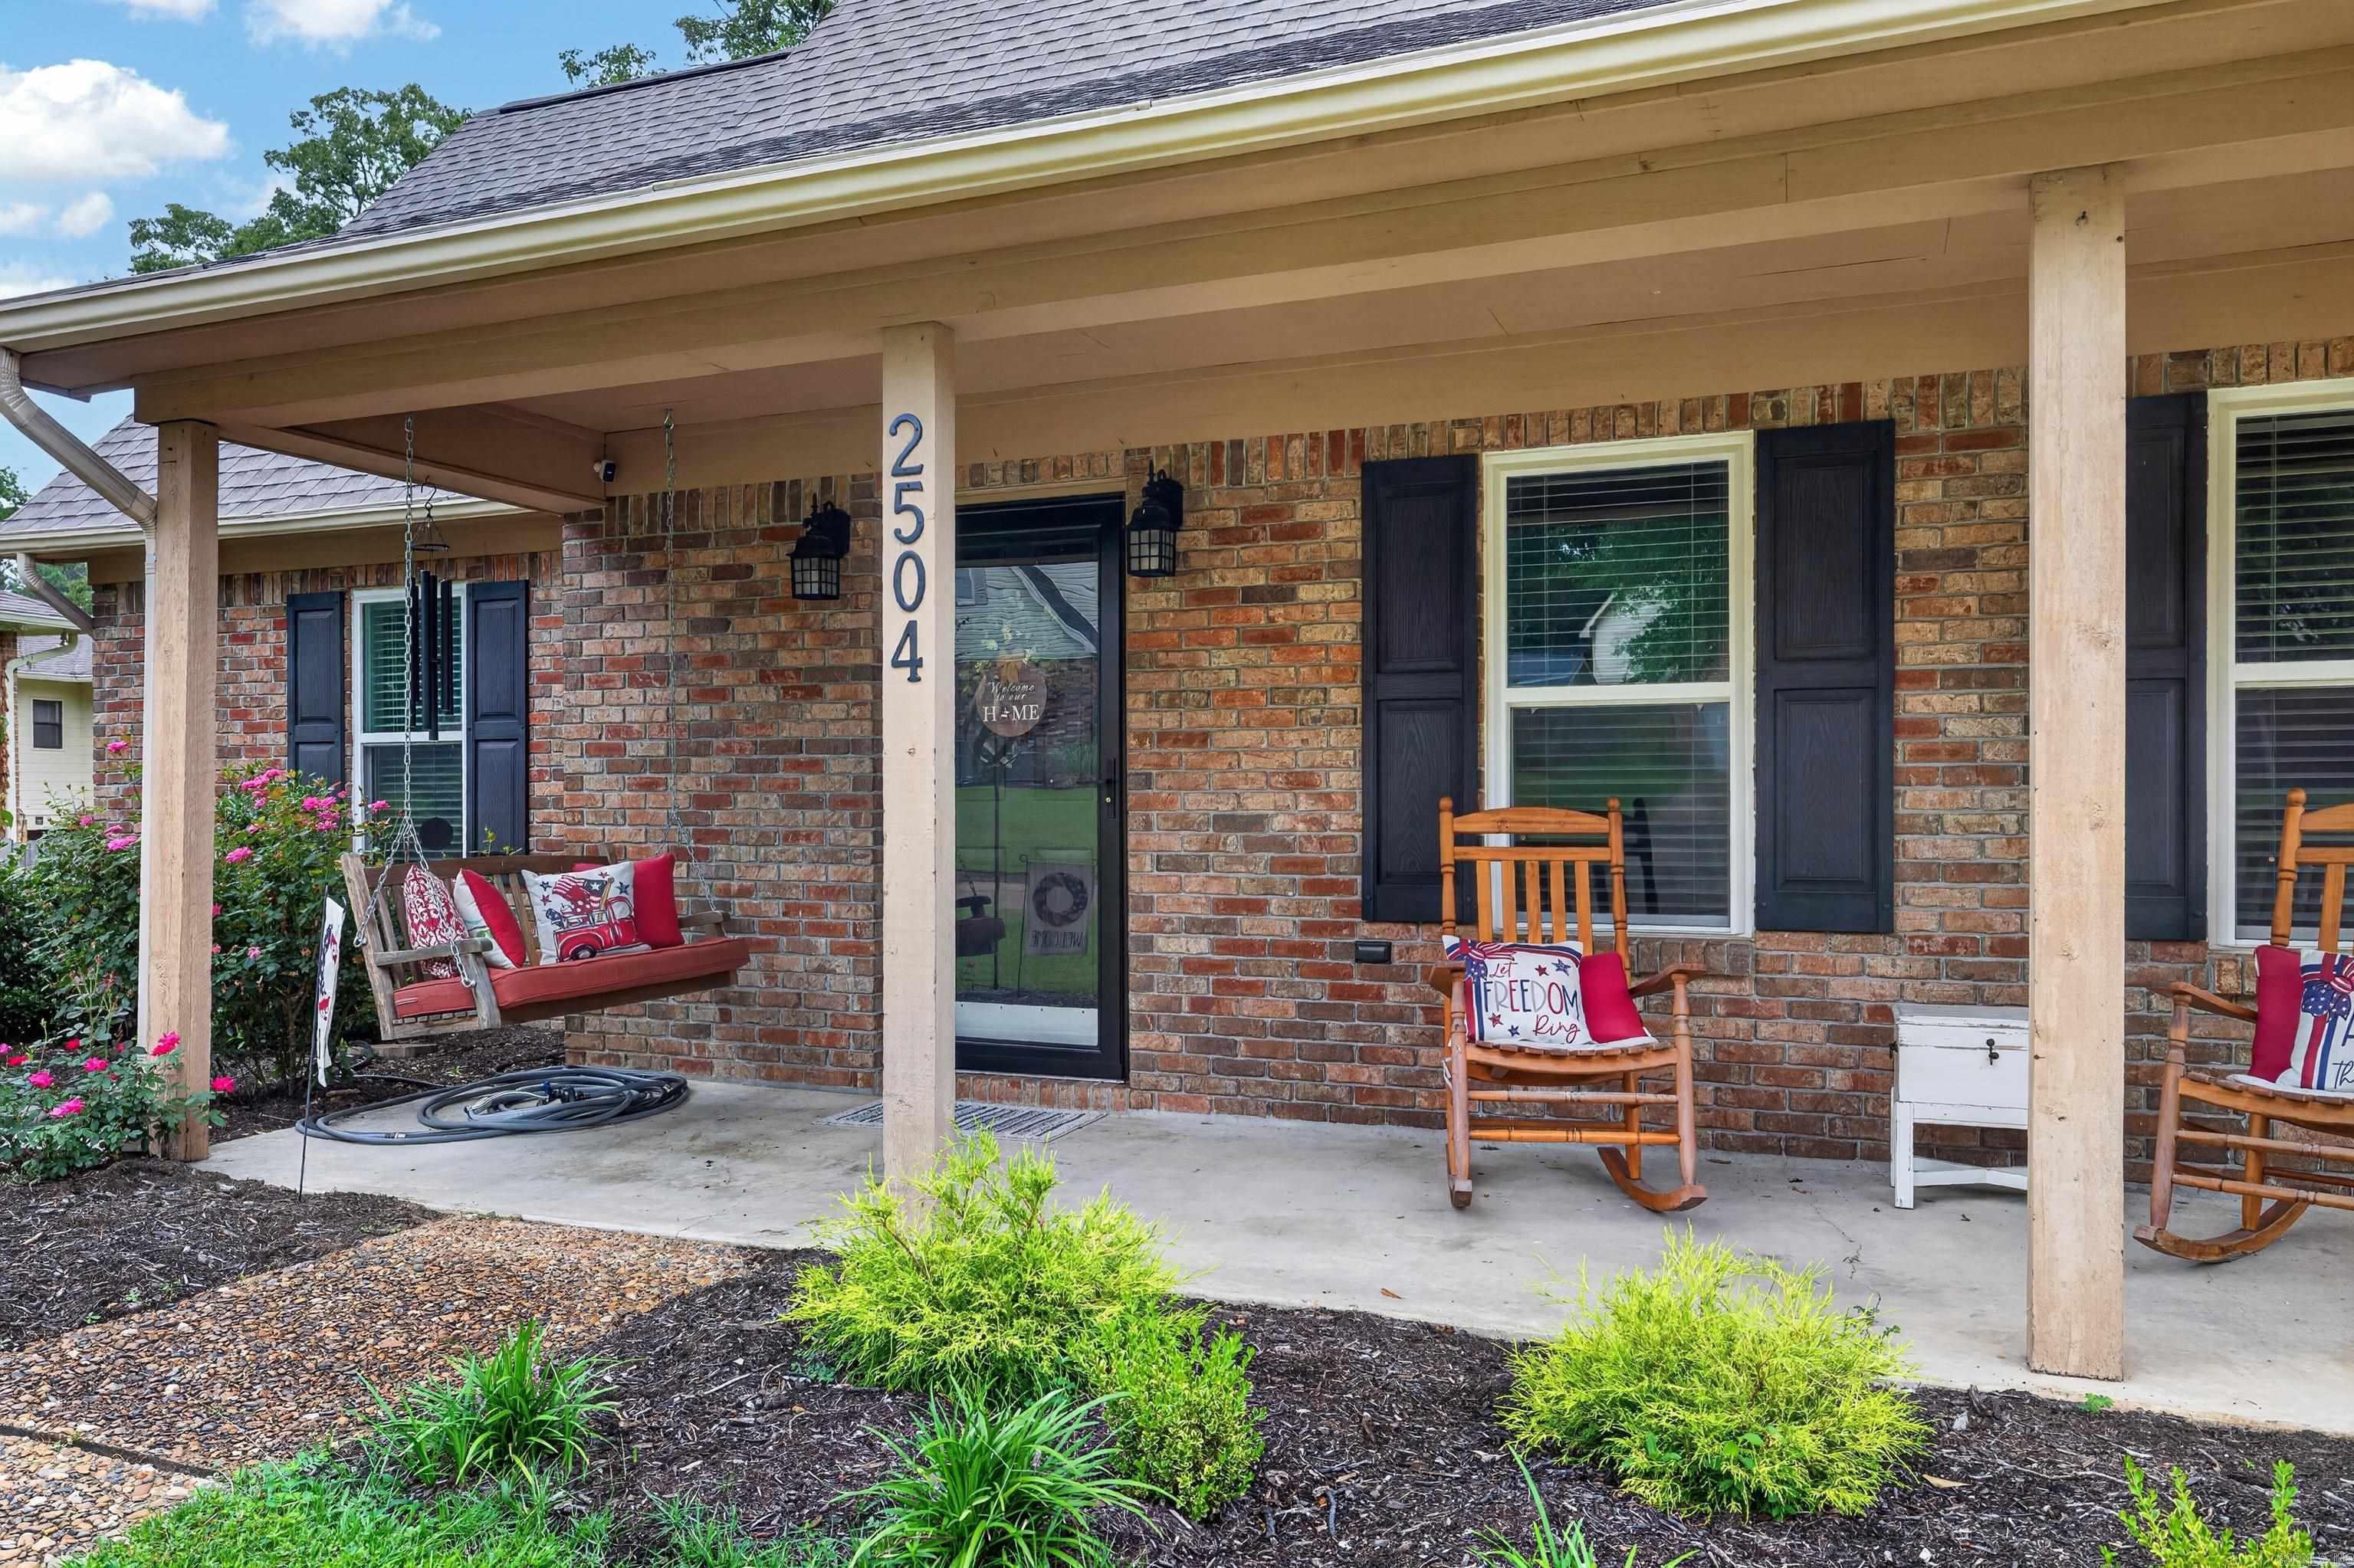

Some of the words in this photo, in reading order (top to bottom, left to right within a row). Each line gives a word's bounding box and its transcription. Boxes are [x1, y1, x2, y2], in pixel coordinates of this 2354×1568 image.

[889, 412, 926, 683] 2504
[988, 681, 1035, 694] Welcome
[983, 704, 1040, 723] HME
[1489, 960, 1518, 979] Let
[1483, 979, 1581, 1020] FREEDOM
[1533, 1014, 1581, 1044] Ring
